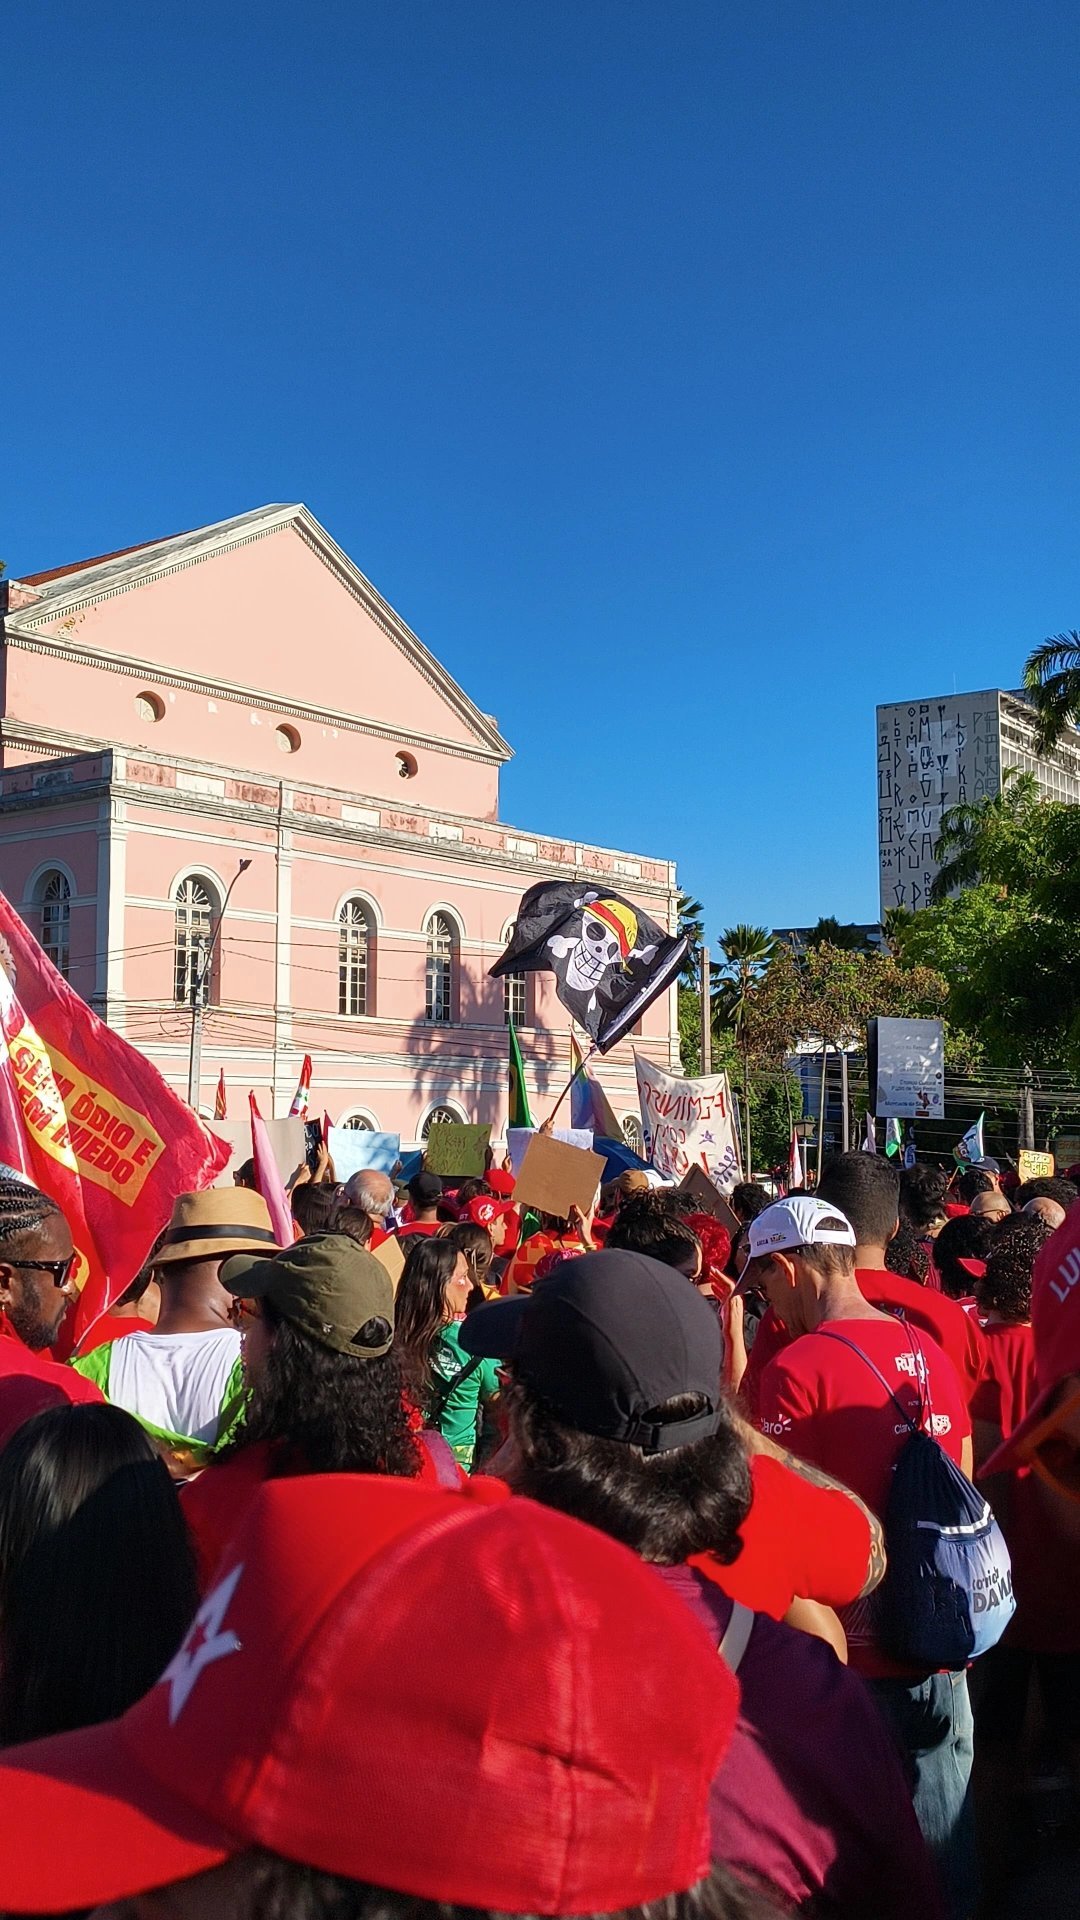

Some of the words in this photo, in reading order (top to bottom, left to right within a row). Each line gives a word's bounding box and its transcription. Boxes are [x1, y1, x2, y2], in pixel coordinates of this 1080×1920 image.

[51, 1119, 135, 1185] MEDO
[70, 1091, 136, 1151] ÓDIO
[130, 1137, 158, 1167] E
